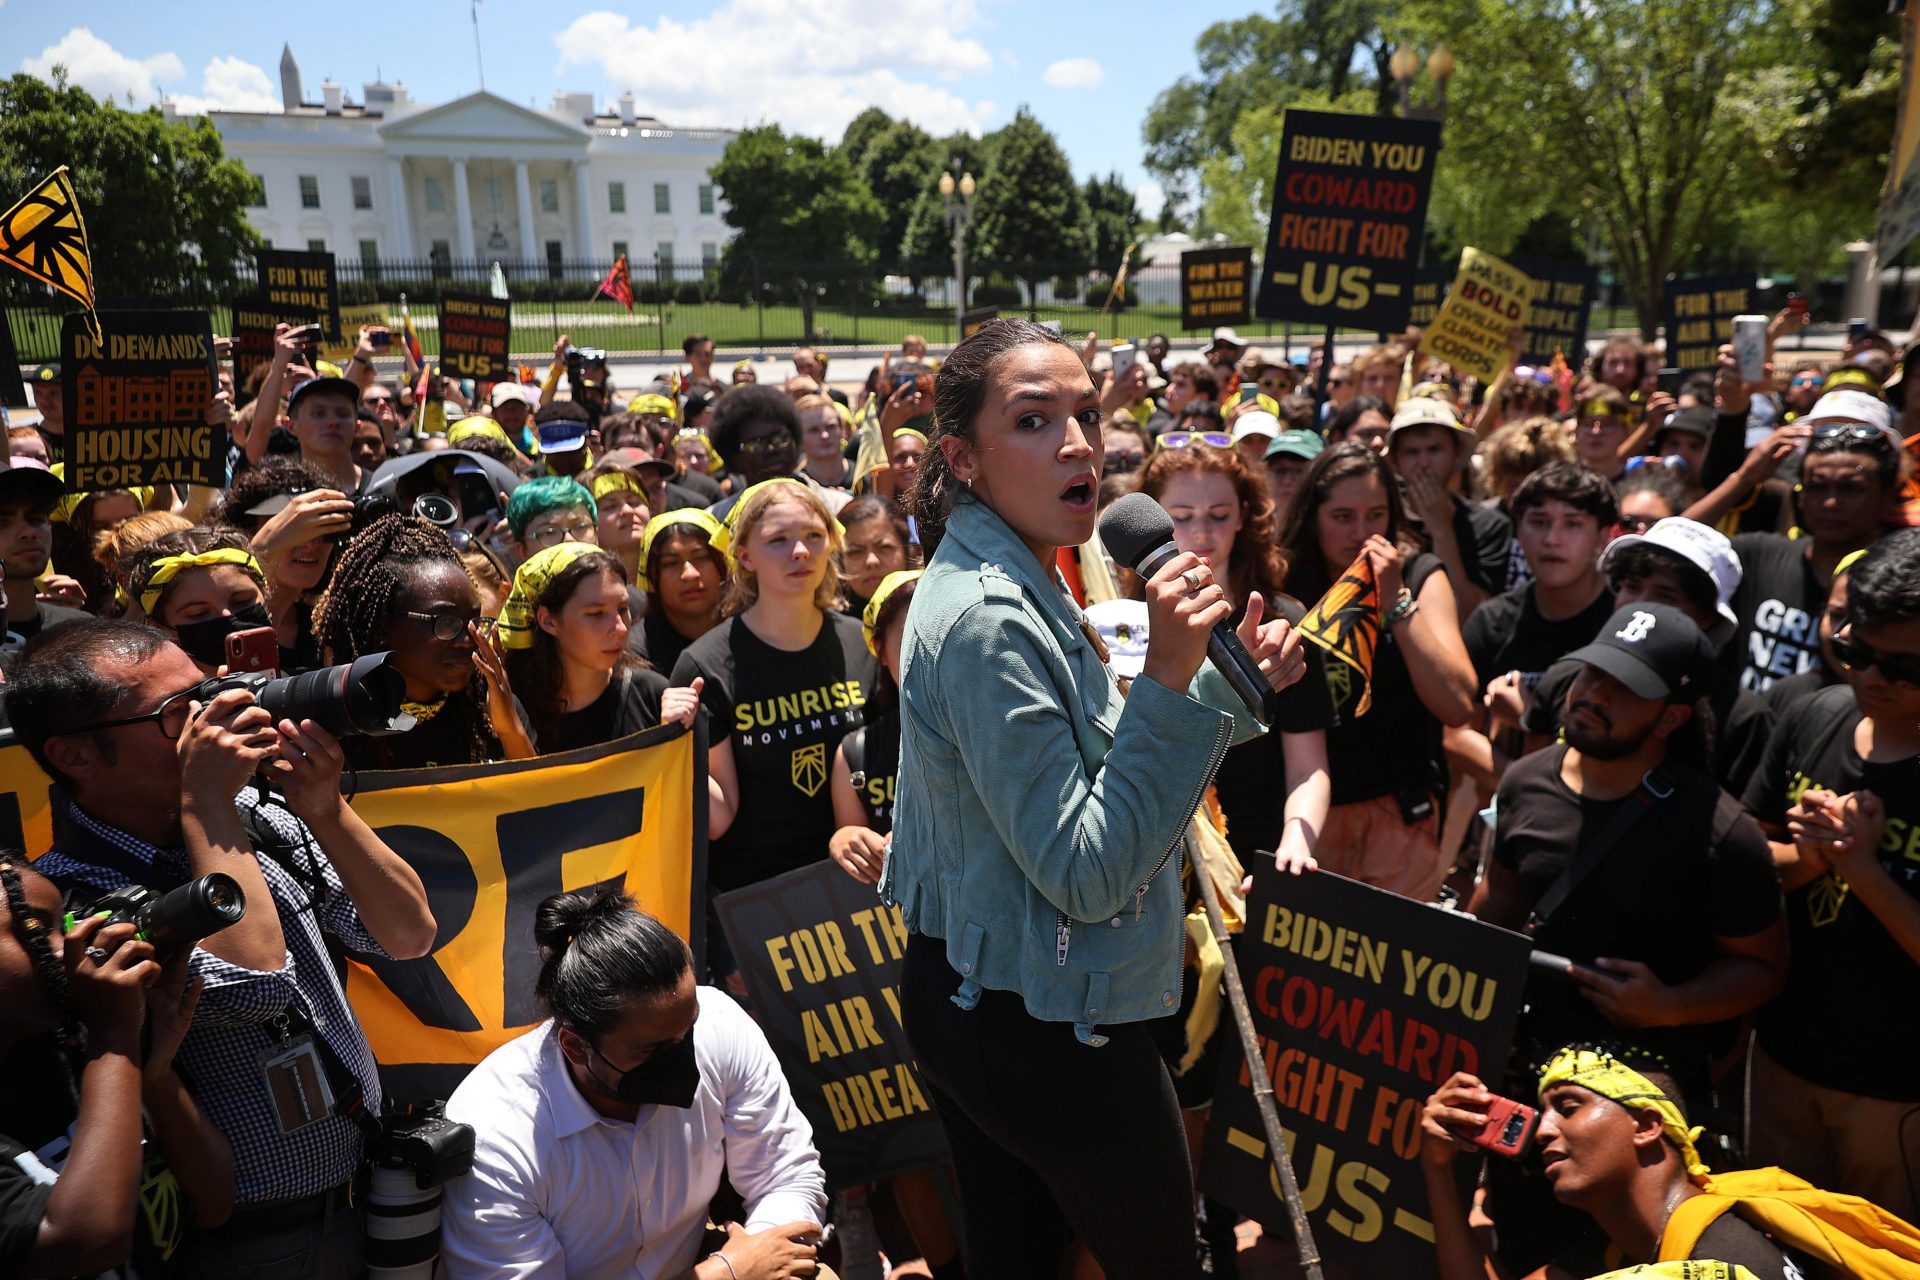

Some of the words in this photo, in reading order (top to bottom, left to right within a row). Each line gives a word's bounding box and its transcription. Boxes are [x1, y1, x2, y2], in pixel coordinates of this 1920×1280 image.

[1290, 135, 1365, 167] BIDEN
[1371, 142, 1426, 173] YOU
[1286, 172, 1417, 214] COWARD
[1278, 213, 1354, 253] FIGHT
[1356, 221, 1410, 260] FOR
[267, 267, 297, 286] FOR
[300, 269, 328, 288] THE
[1188, 264, 1216, 281] FOR
[1218, 261, 1245, 278] THE
[1470, 259, 1514, 292] PASS
[445, 300, 480, 315] BIDEN
[483, 304, 506, 319] YOU
[1189, 281, 1244, 301] WATER
[1461, 279, 1522, 322] BOLD
[1674, 293, 1711, 317] FOR
[1713, 288, 1749, 313] THE
[446, 316, 505, 337] COWARD
[446, 333, 478, 352] FIGHT
[482, 337, 504, 354] FOR
[1677, 321, 1712, 344] AIR
[110, 334, 208, 360] DEMANDS
[1430, 334, 1496, 374] CORPS
[76, 427, 211, 464] HOUSING
[76, 463, 142, 488] FOR
[151, 461, 208, 482] ALL
[735, 680, 866, 731] SUNRISE
[743, 709, 864, 747] MOVEMEN
[765, 920, 857, 993] FOR
[850, 901, 909, 966] TH
[1263, 903, 1389, 985] BIDEN
[1400, 949, 1497, 1022] YOU
[801, 995, 885, 1064] AIR
[1255, 964, 1480, 1086] COWARD
[1367, 1085, 1424, 1161] FO
